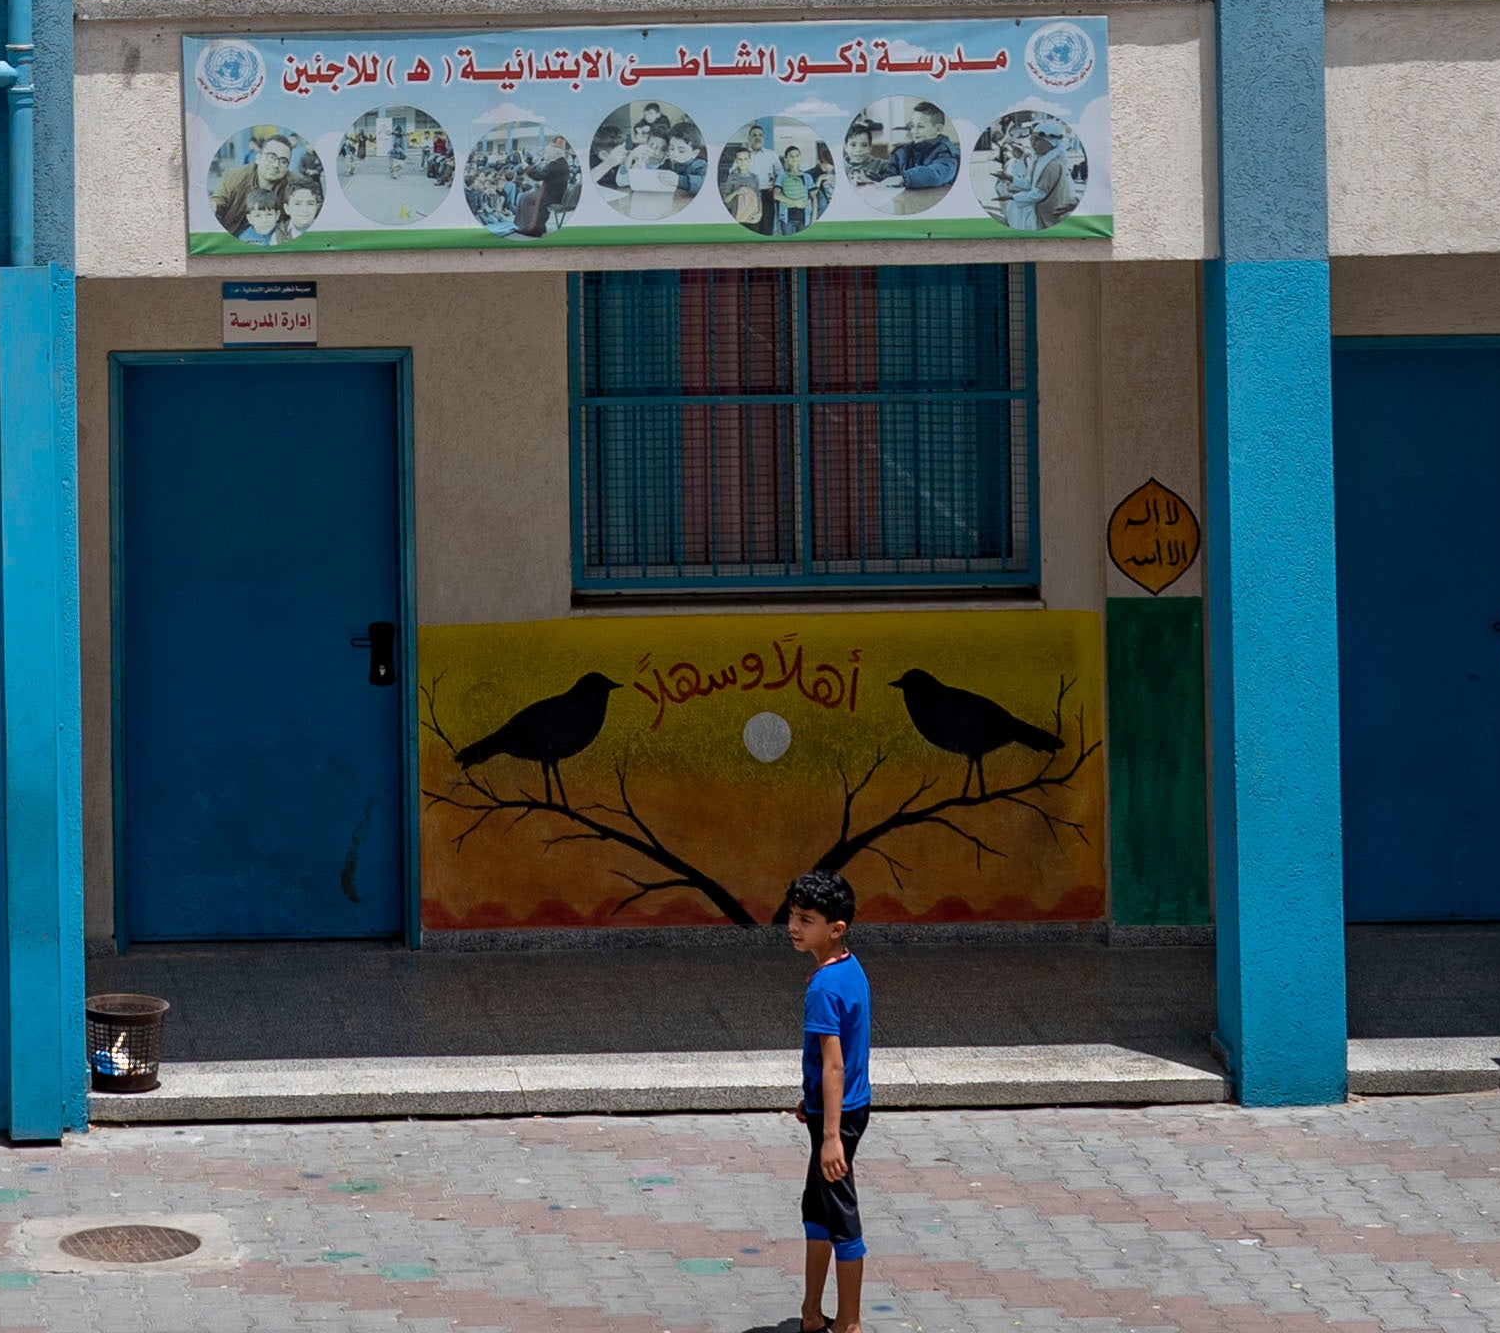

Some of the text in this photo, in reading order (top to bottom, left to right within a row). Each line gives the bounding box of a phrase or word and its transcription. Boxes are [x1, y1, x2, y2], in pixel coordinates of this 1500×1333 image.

[283, 52, 379, 95] للاجئين
[457, 49, 613, 90] الابتدائية
[619, 42, 775, 86] الشاطئ
[779, 40, 868, 83] ذكور
[873, 40, 1007, 79] مدرسة
[229, 311, 311, 330] إدارة المدرسة
[1165, 498, 1179, 526] لا
[1123, 537, 1162, 568] الله
